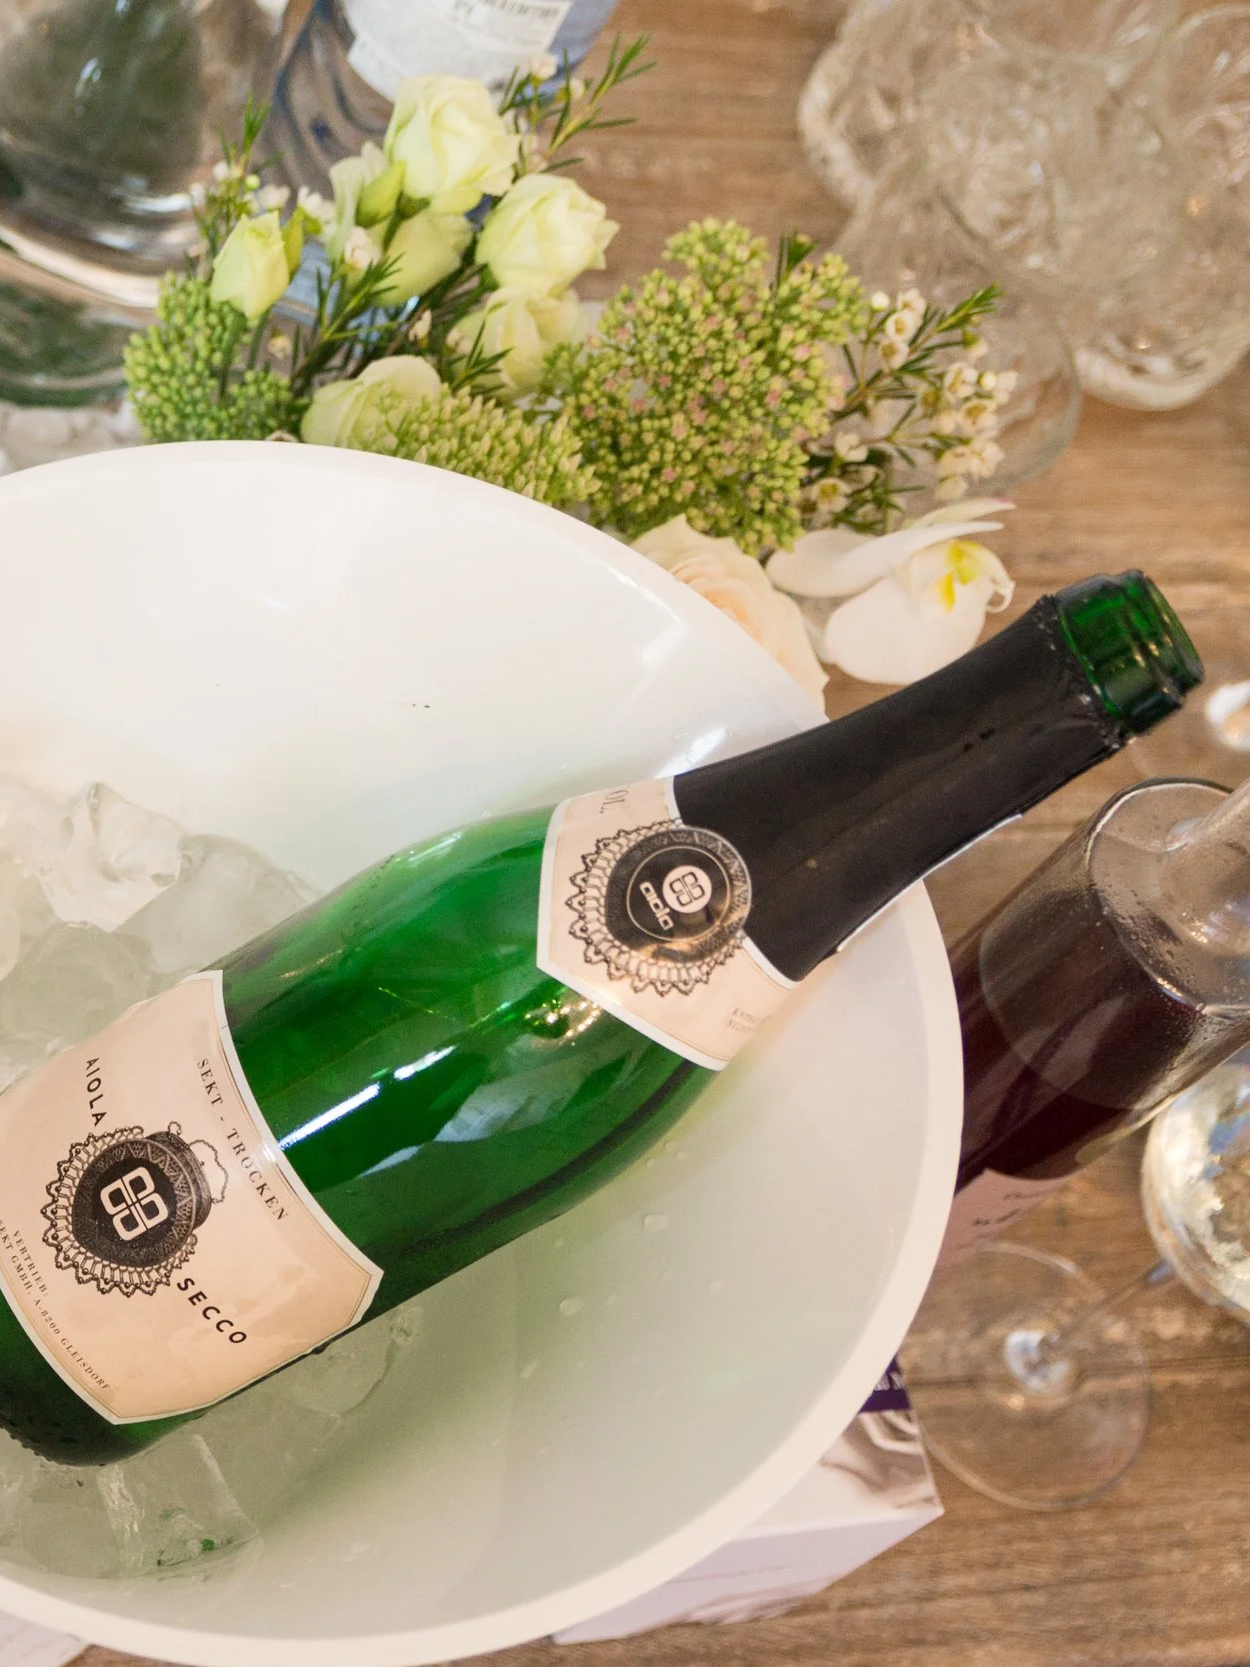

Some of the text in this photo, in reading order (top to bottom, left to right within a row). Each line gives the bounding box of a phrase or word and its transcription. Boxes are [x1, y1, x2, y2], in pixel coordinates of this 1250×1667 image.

[85, 1057, 107, 1127] AIOLA
[197, 1058, 223, 1105] SEKT
[227, 1128, 289, 1221] TROCKEN
[12, 1229, 49, 1297] VERTRIEB:
[177, 1277, 247, 1344] SECCO
[60, 1337, 111, 1391] GLEISDORF
